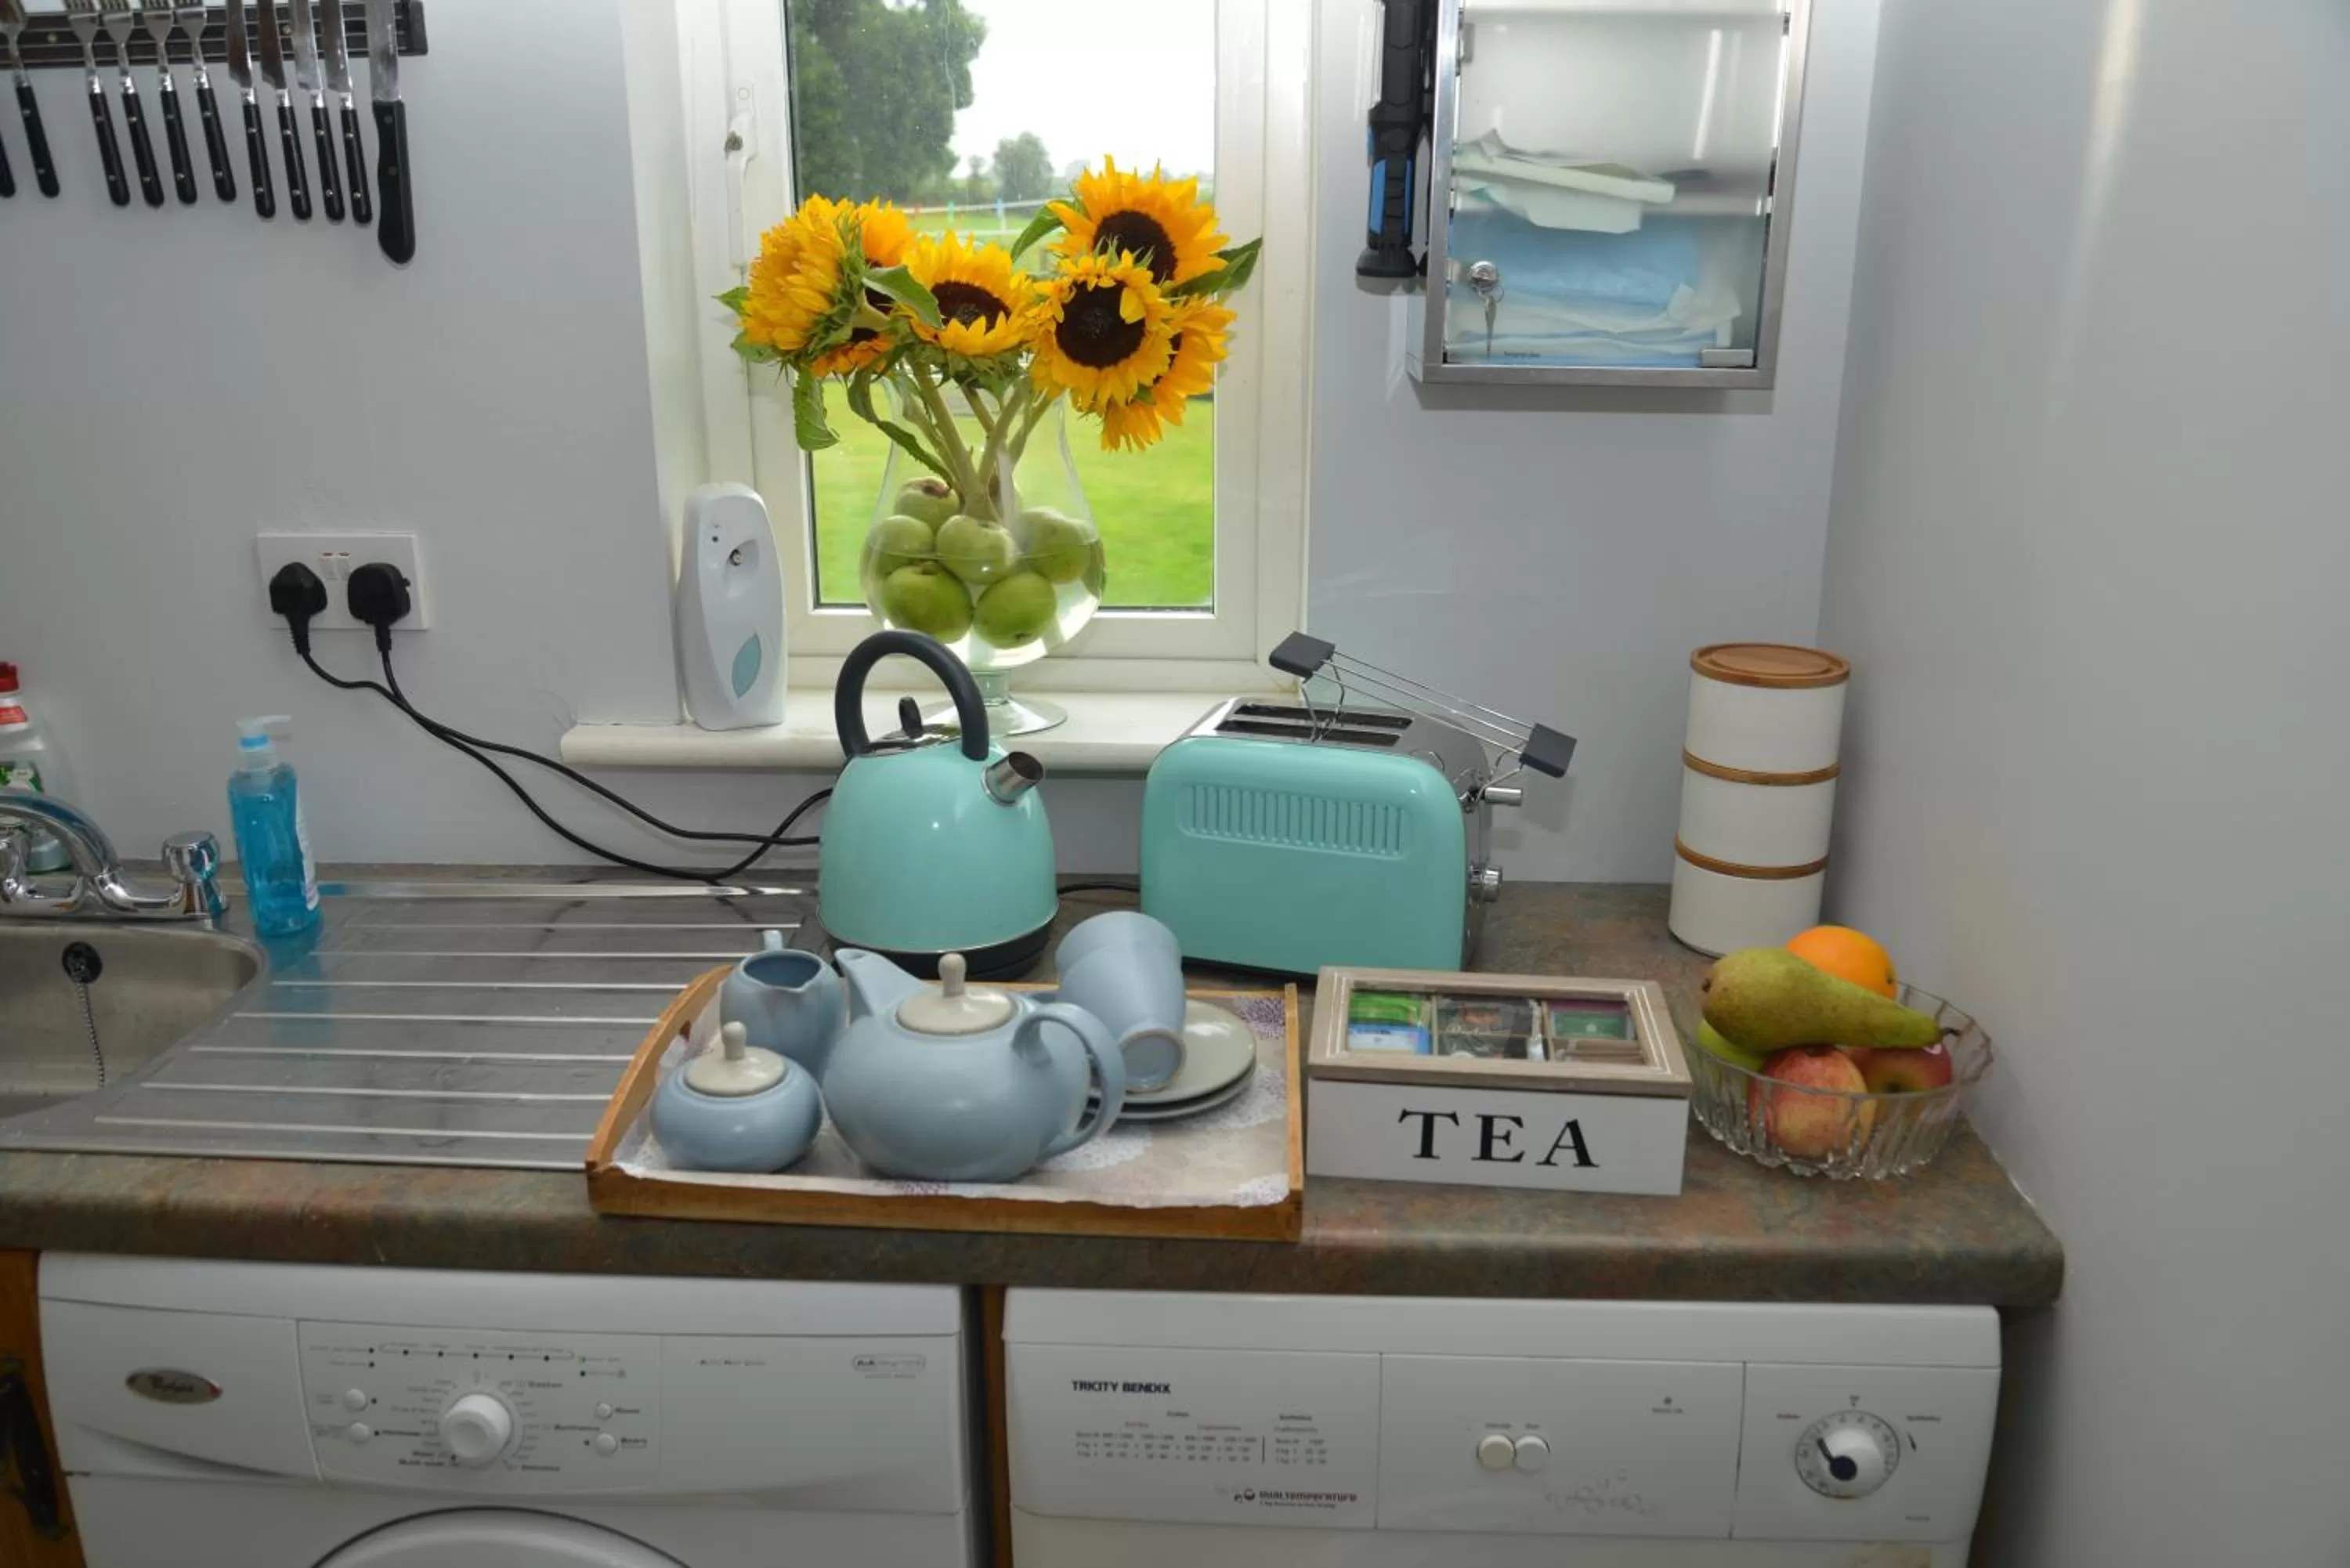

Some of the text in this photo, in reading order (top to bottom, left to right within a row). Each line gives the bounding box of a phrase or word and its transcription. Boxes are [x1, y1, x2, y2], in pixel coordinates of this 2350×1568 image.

[1397, 1107, 1600, 1168] TEA
[1072, 1380, 1171, 1394] TRICITY BENDIX
